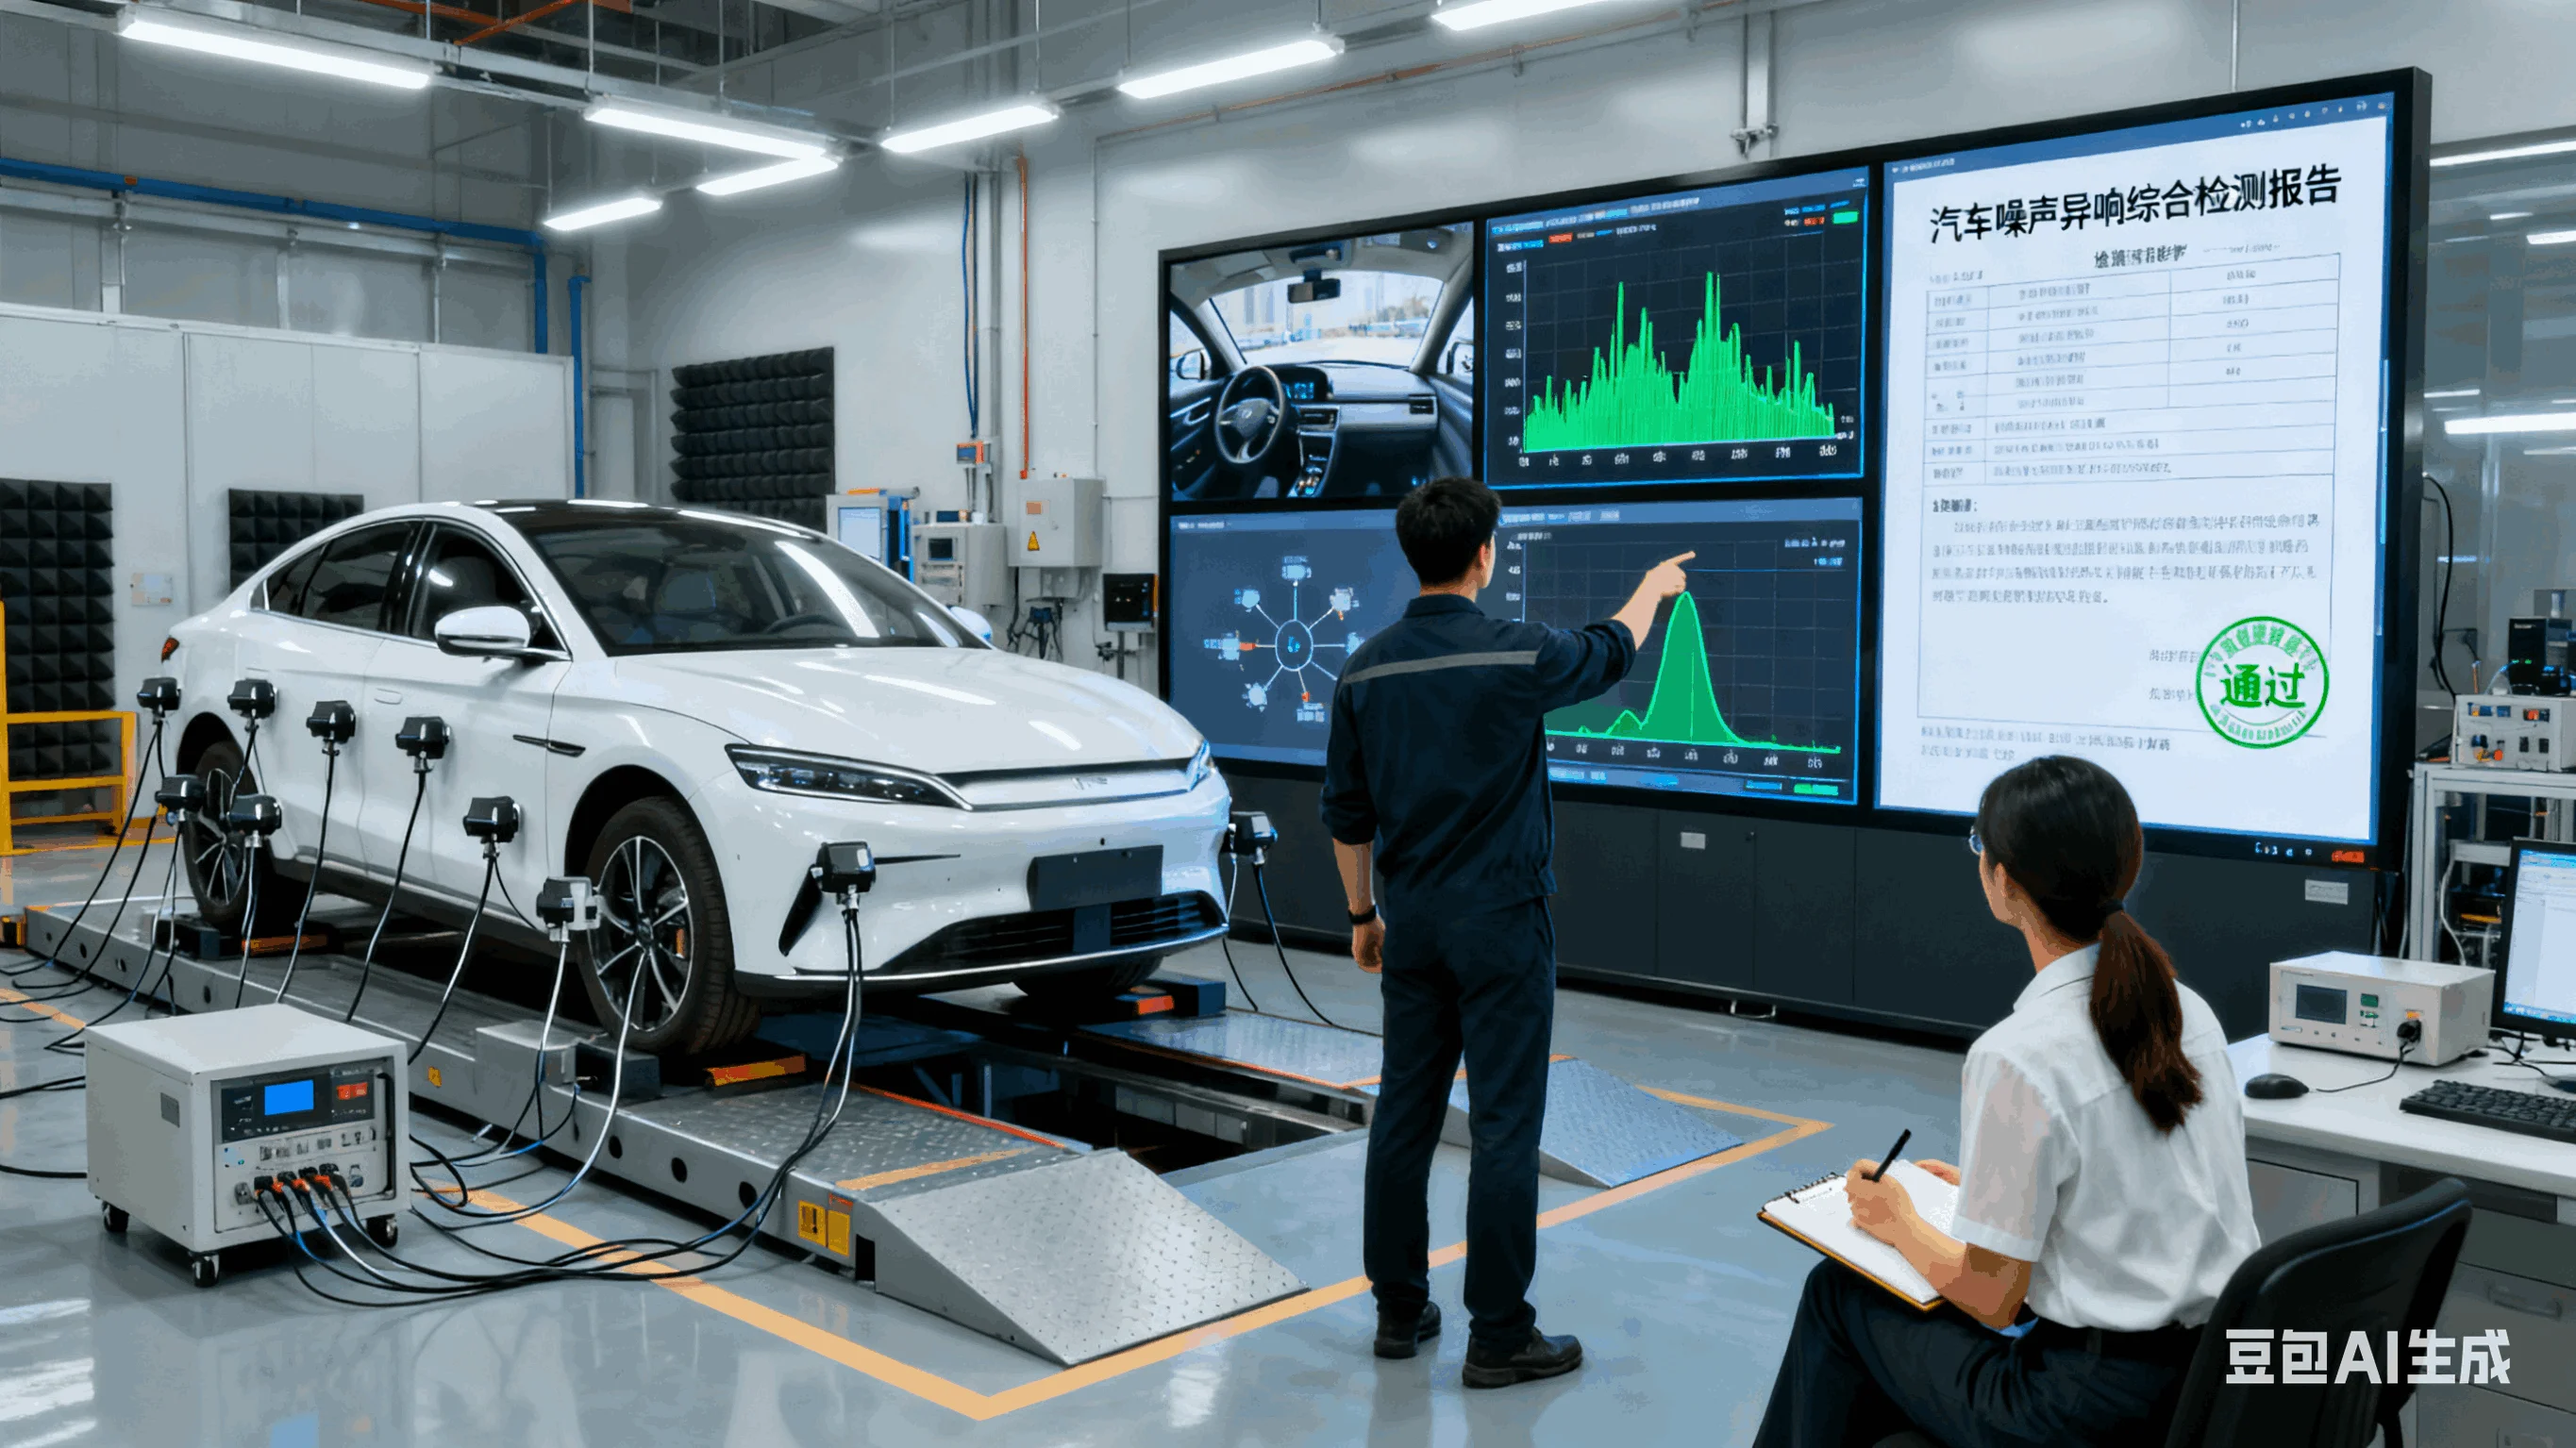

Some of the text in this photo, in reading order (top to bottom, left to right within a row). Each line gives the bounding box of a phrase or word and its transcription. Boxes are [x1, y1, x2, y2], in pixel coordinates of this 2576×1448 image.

[1930, 163, 2342, 243] 汽车噪声异响综合检测报告
[2219, 662, 2306, 708] 通过
